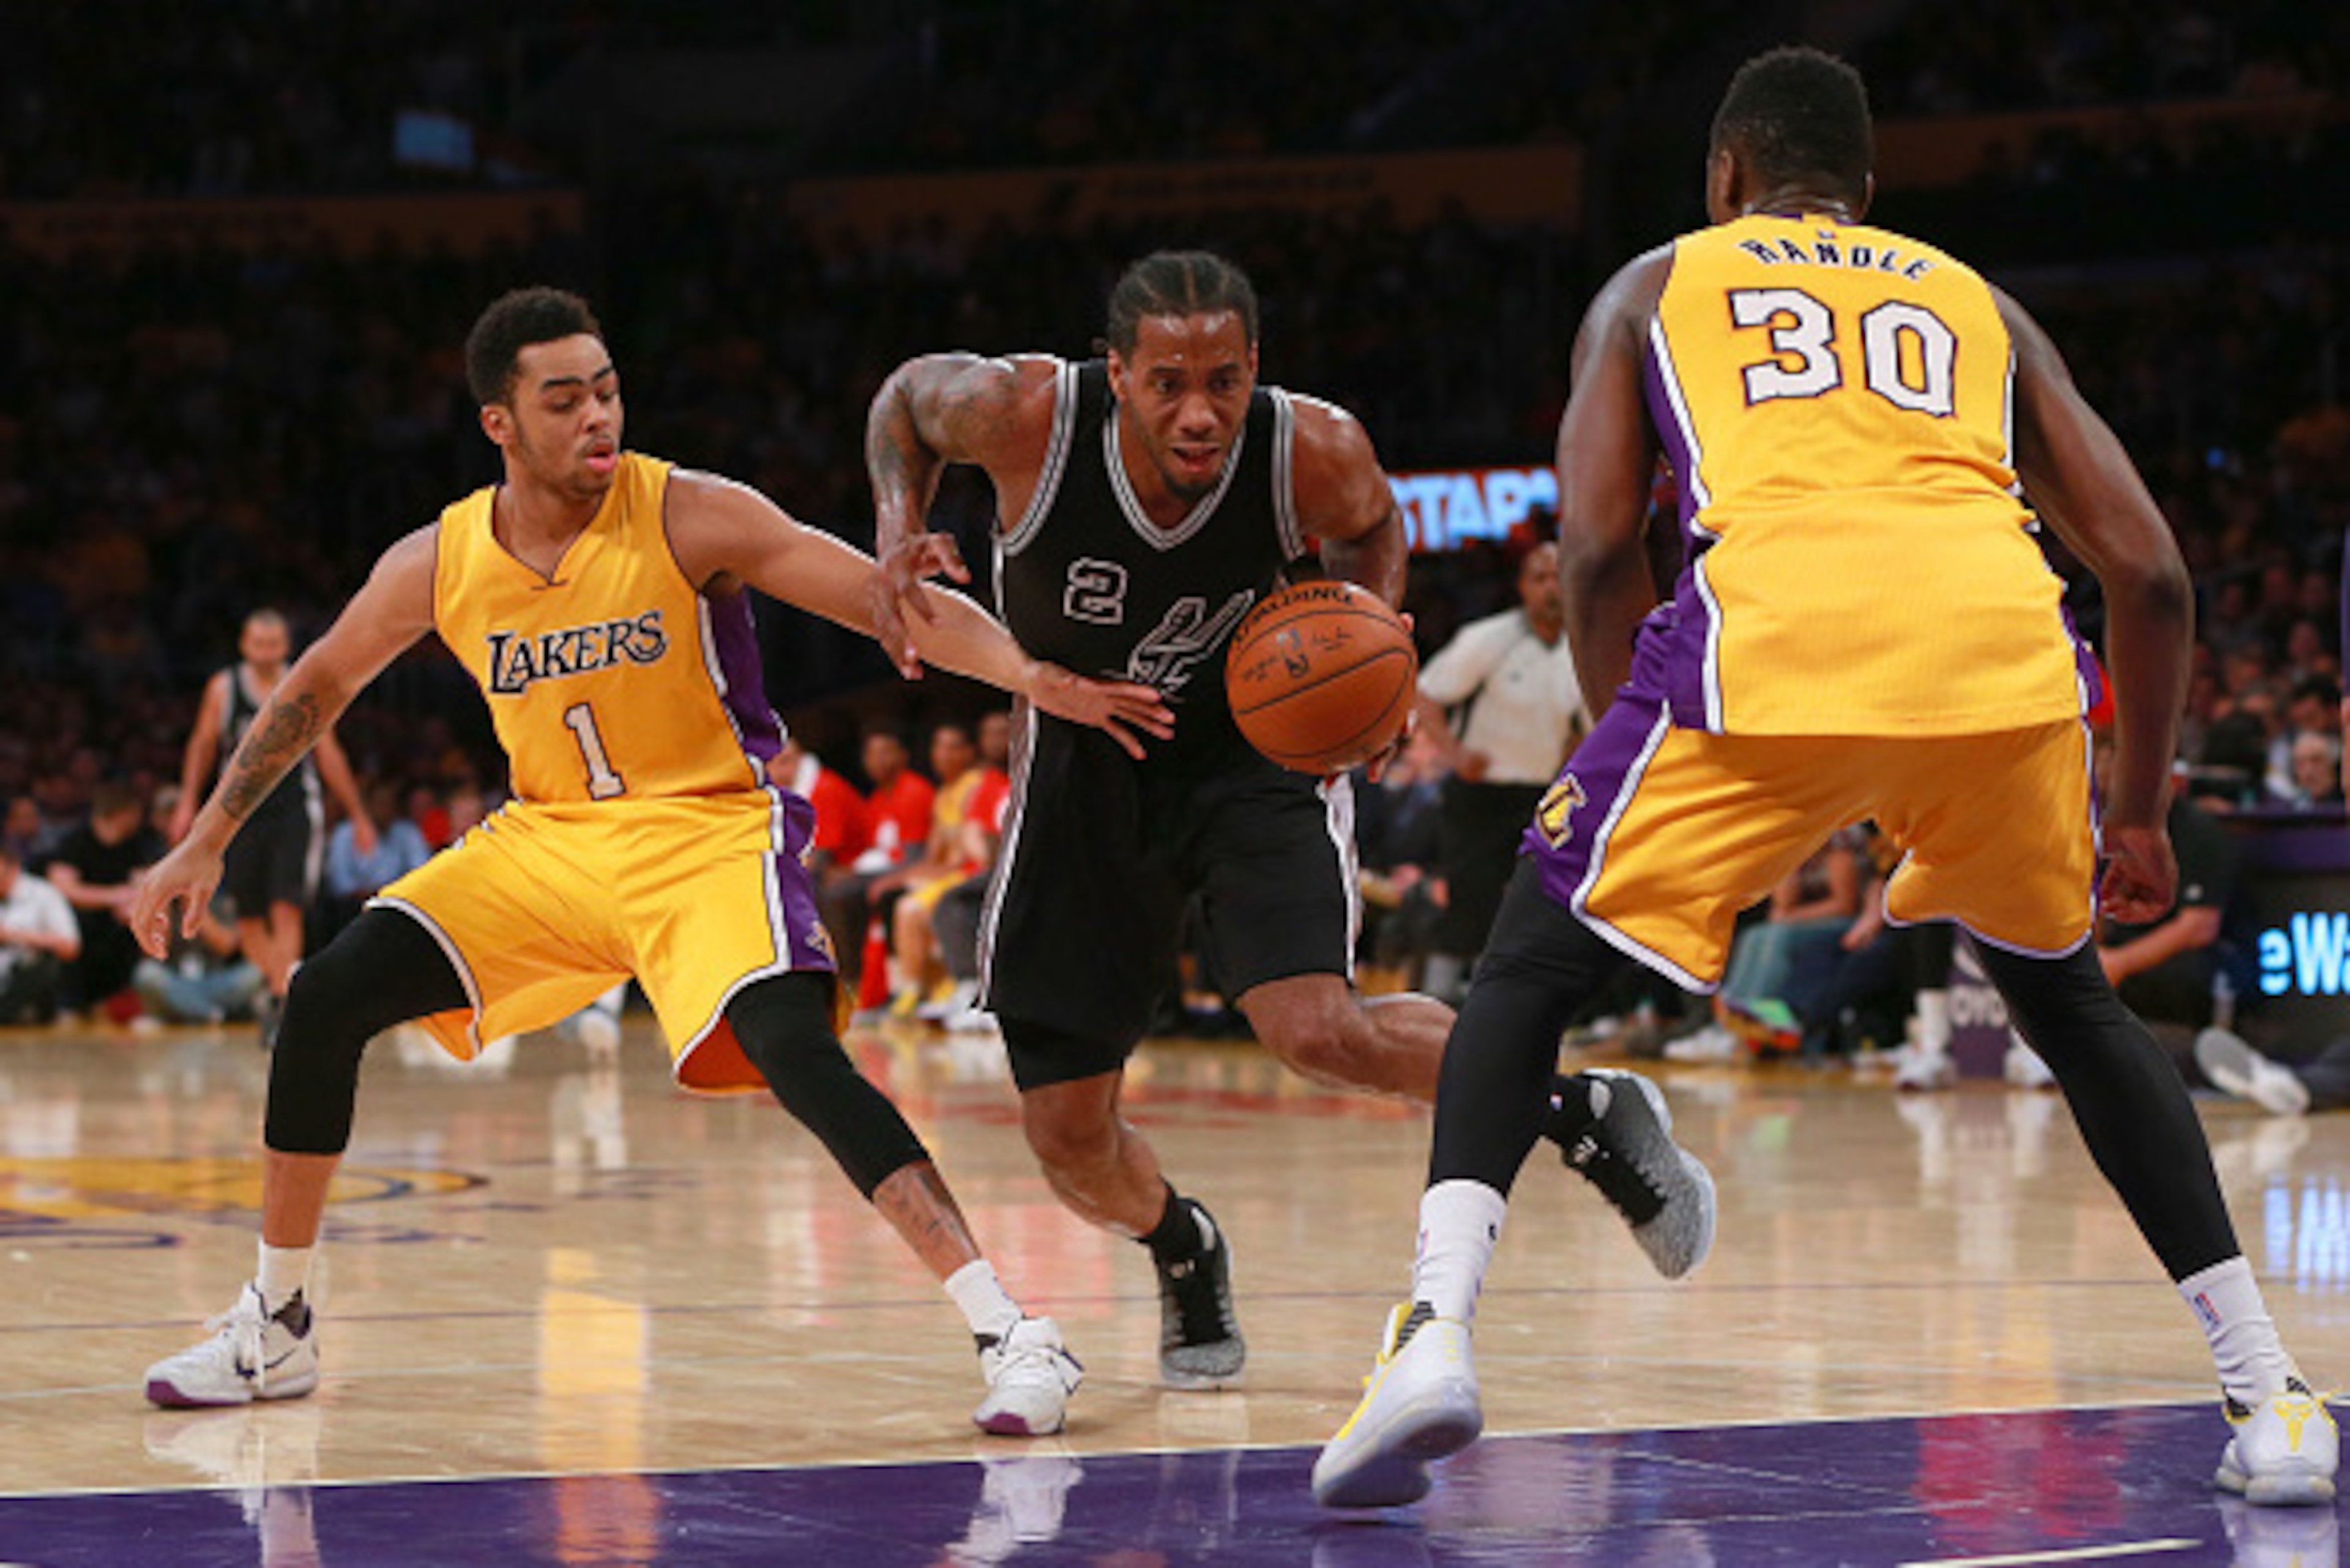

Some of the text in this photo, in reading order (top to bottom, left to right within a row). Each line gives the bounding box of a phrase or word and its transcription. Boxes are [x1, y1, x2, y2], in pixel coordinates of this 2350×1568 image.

[1738, 236, 1936, 280] RANDLE
[1726, 288, 1958, 419] 30
[1063, 556, 1128, 625] 2
[486, 608, 668, 696] LAKERS
[564, 702, 626, 800] 1
[2258, 911, 2350, 996] eW
